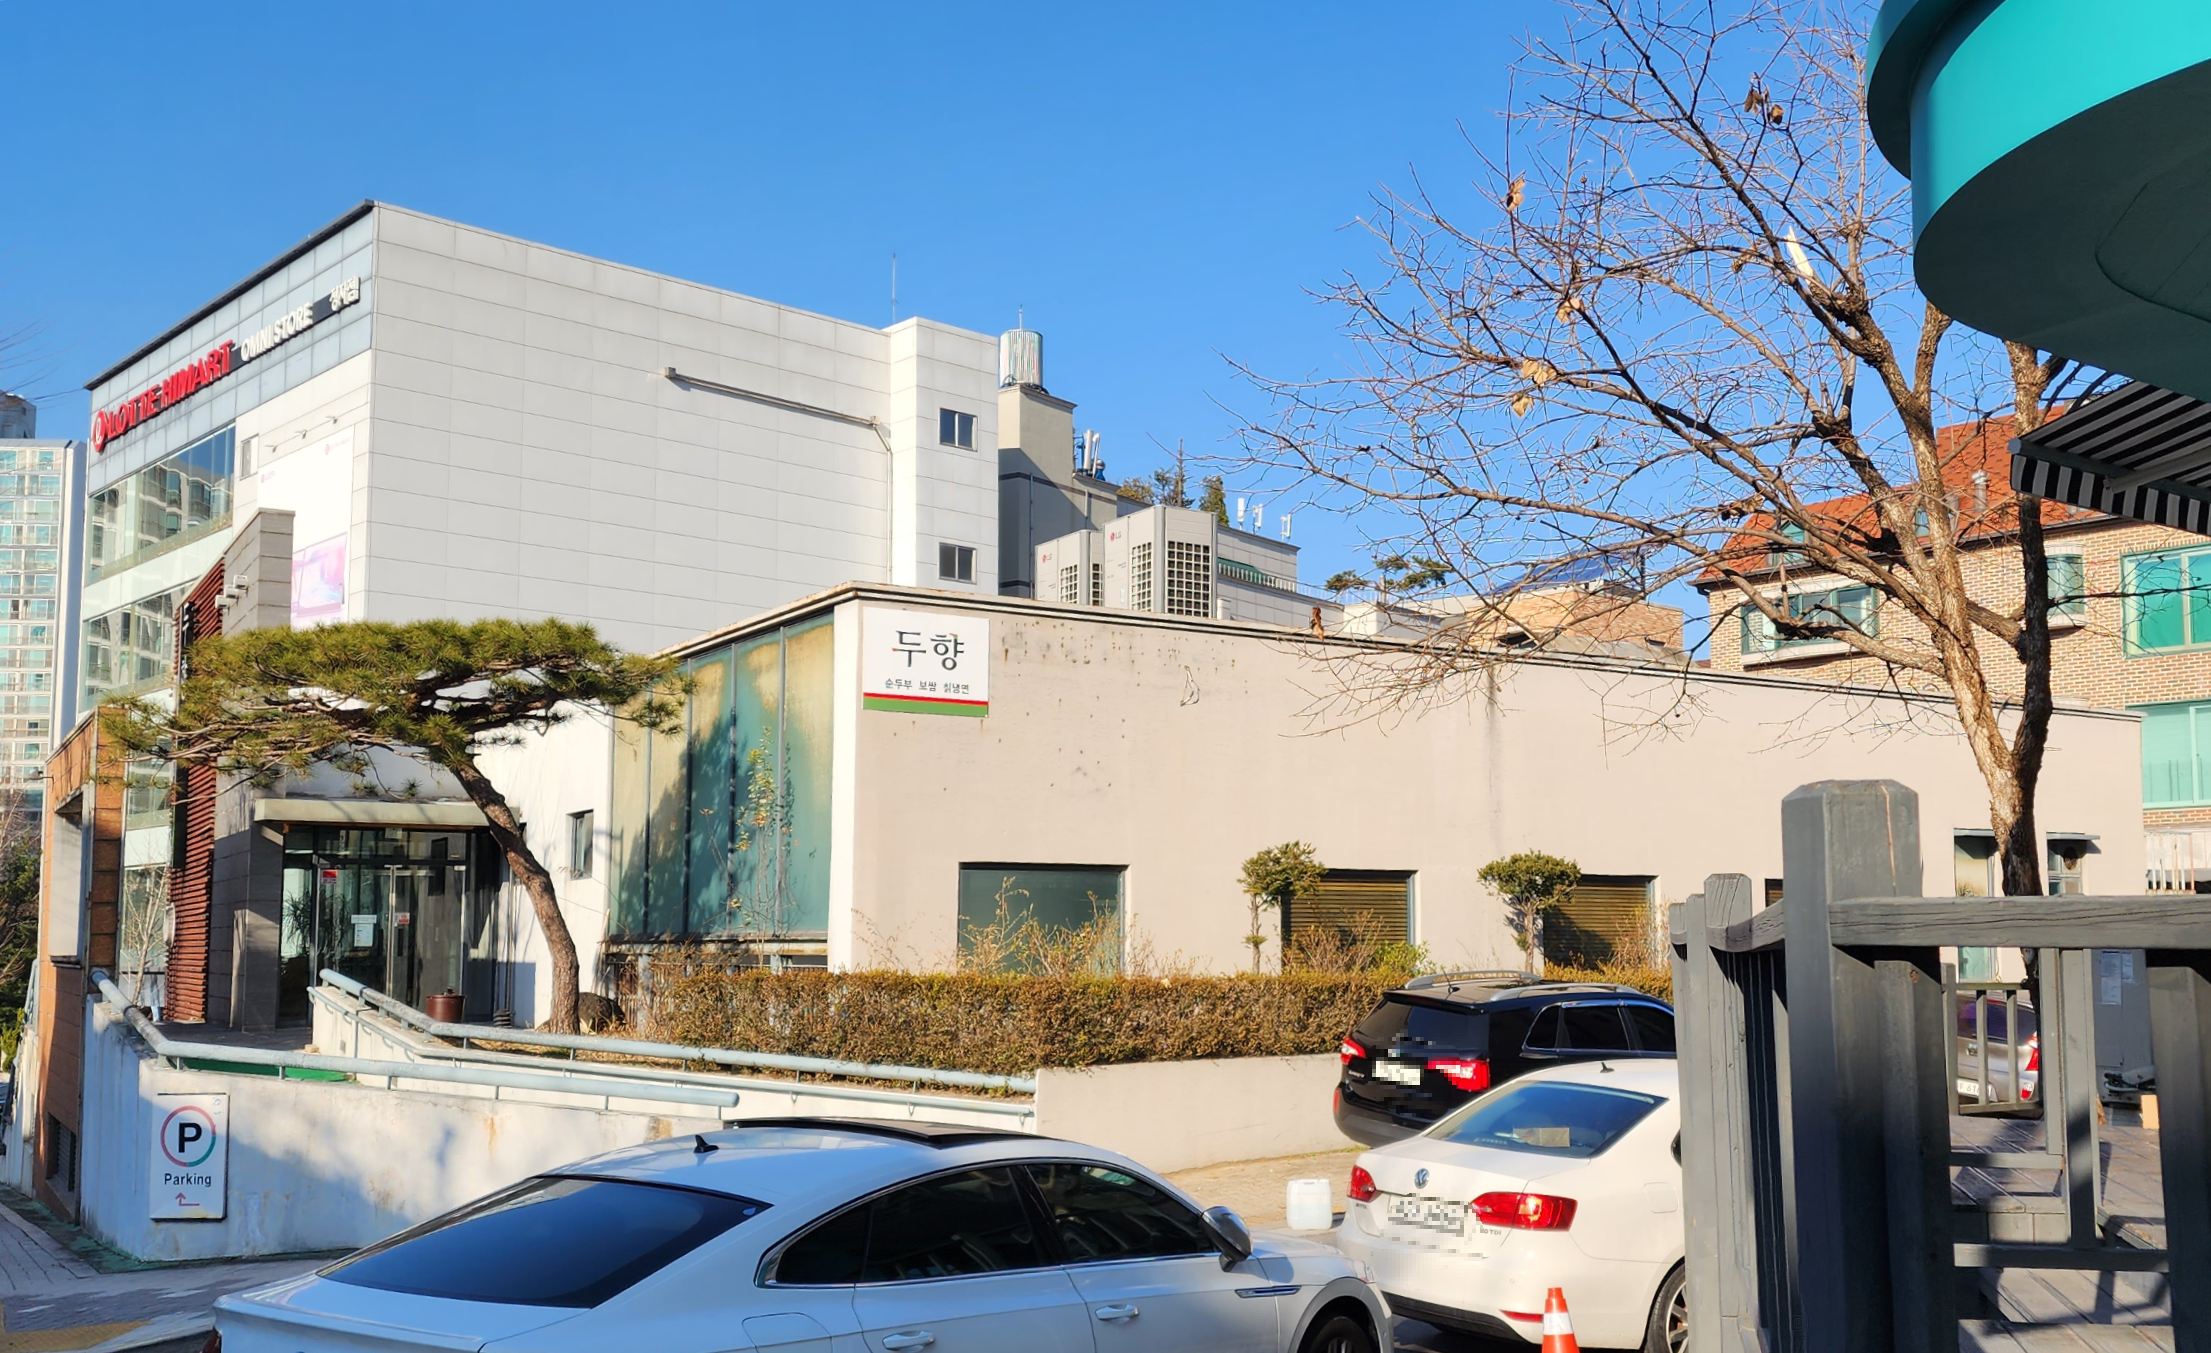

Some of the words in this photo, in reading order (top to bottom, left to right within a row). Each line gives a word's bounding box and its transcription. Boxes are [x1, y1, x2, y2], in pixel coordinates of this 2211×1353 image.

[107, 384, 160, 439] LOTTE
[160, 339, 234, 408] HIMART
[241, 324, 274, 361] OMNI
[274, 302, 313, 343] STORE
[1115, 531, 1122, 540] LG
[1046, 553, 1053, 561] LG
[891, 630, 965, 671] 두향
[885, 678, 912, 690] 순두부
[918, 680, 937, 692] 보쌈
[944, 682, 969, 694] 칡냉면
[178, 1122, 203, 1153] P
[164, 1172, 212, 1188] Parking
